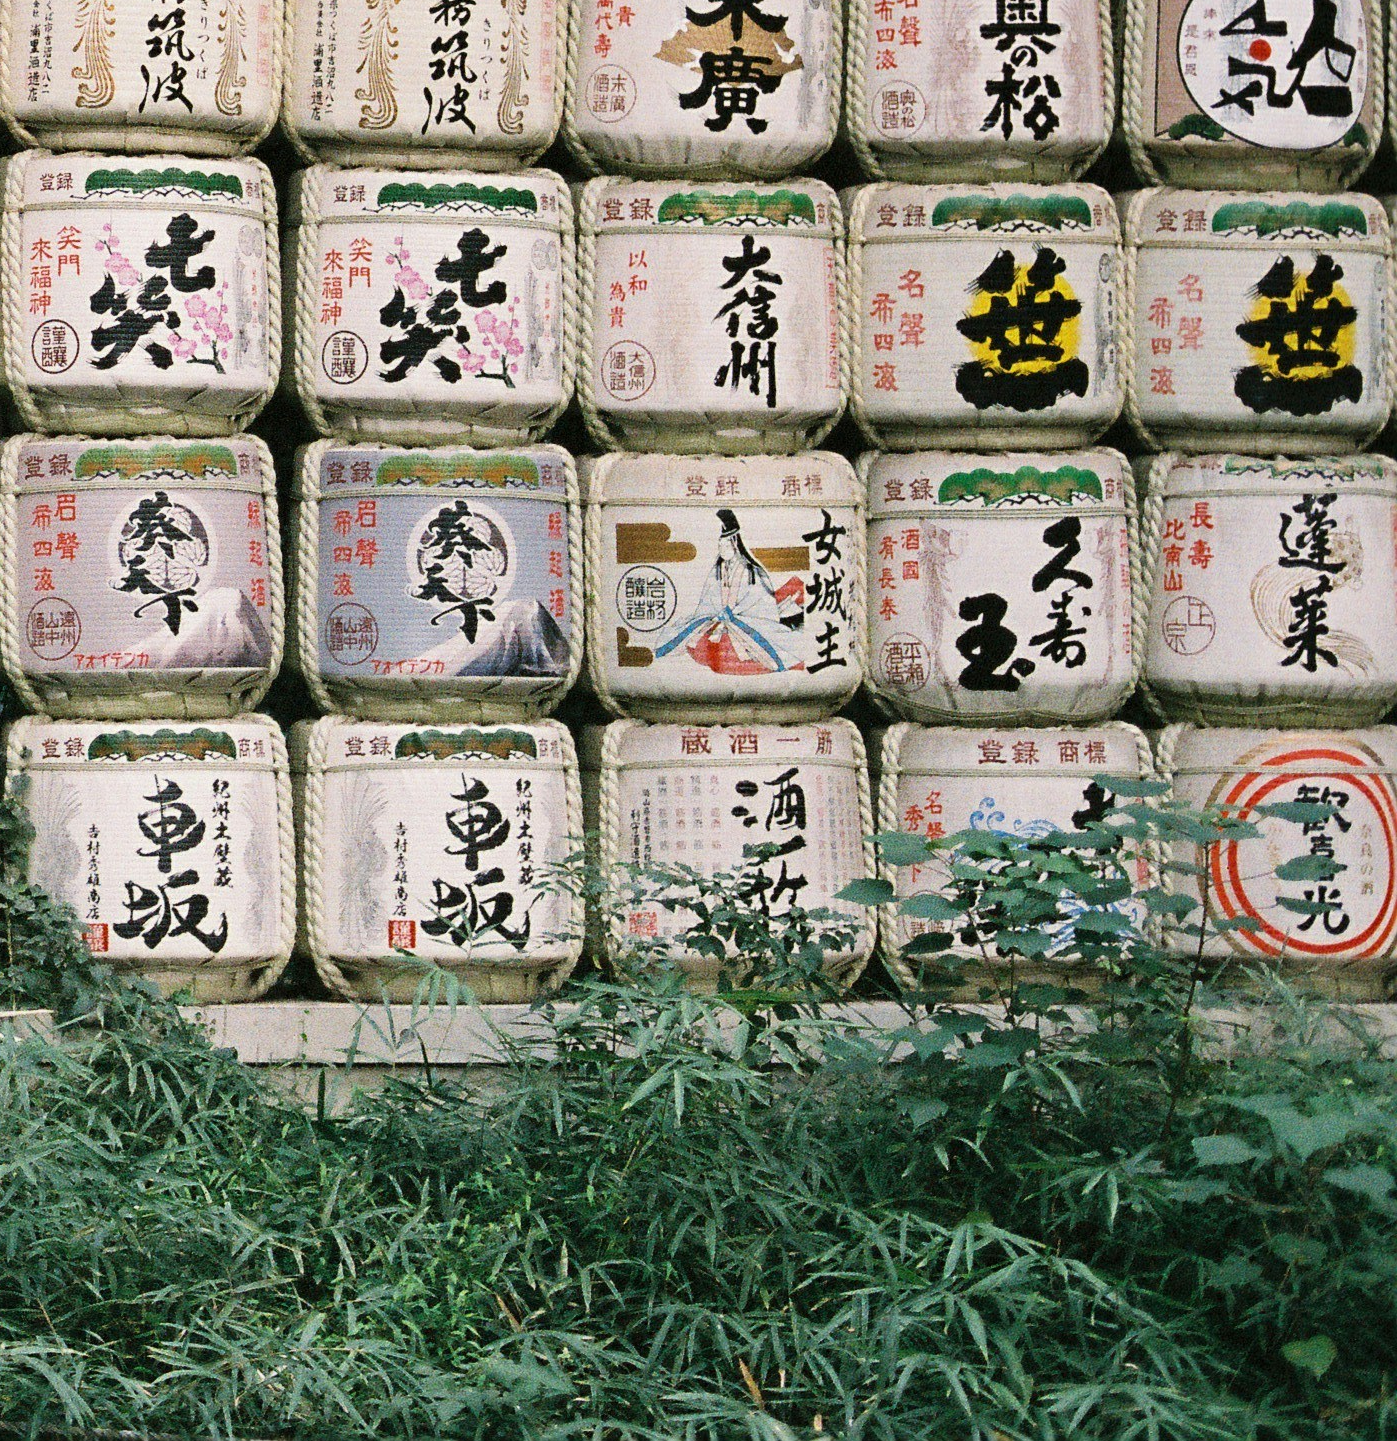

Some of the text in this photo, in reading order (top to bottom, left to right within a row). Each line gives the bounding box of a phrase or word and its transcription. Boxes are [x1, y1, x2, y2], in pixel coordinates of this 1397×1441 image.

[480, 17, 491, 100] きりつくば
[57, 226, 81, 275] 笑門
[348, 238, 371, 286] 笑門
[877, 205, 925, 228] 登録
[1157, 209, 1206, 232] 登録
[90, 214, 215, 370] 七笑
[380, 228, 507, 382] 七笑
[629, 251, 646, 296] 以和
[713, 236, 782, 408] 大信州
[955, 243, 1089, 411] 笹一
[1234, 249, 1362, 416] 笹一
[327, 462, 373, 485] 登録
[885, 481, 933, 502] 登録
[108, 491, 198, 635] 葵天下
[410, 501, 496, 645] 葵天下
[803, 509, 848, 675] 女城主
[74, 654, 149, 667] アオイテンカ
[372, 659, 444, 674] アオイテンカ
[42, 739, 83, 758] 登録
[345, 735, 392, 757] 登録
[87, 824, 102, 919] 吉村秀雄商店
[113, 776, 227, 953] 車坂
[212, 779, 232, 888] 紀州土壁蔵
[392, 822, 409, 916] 吉村秀雄商店
[420, 773, 544, 950] 車坂
